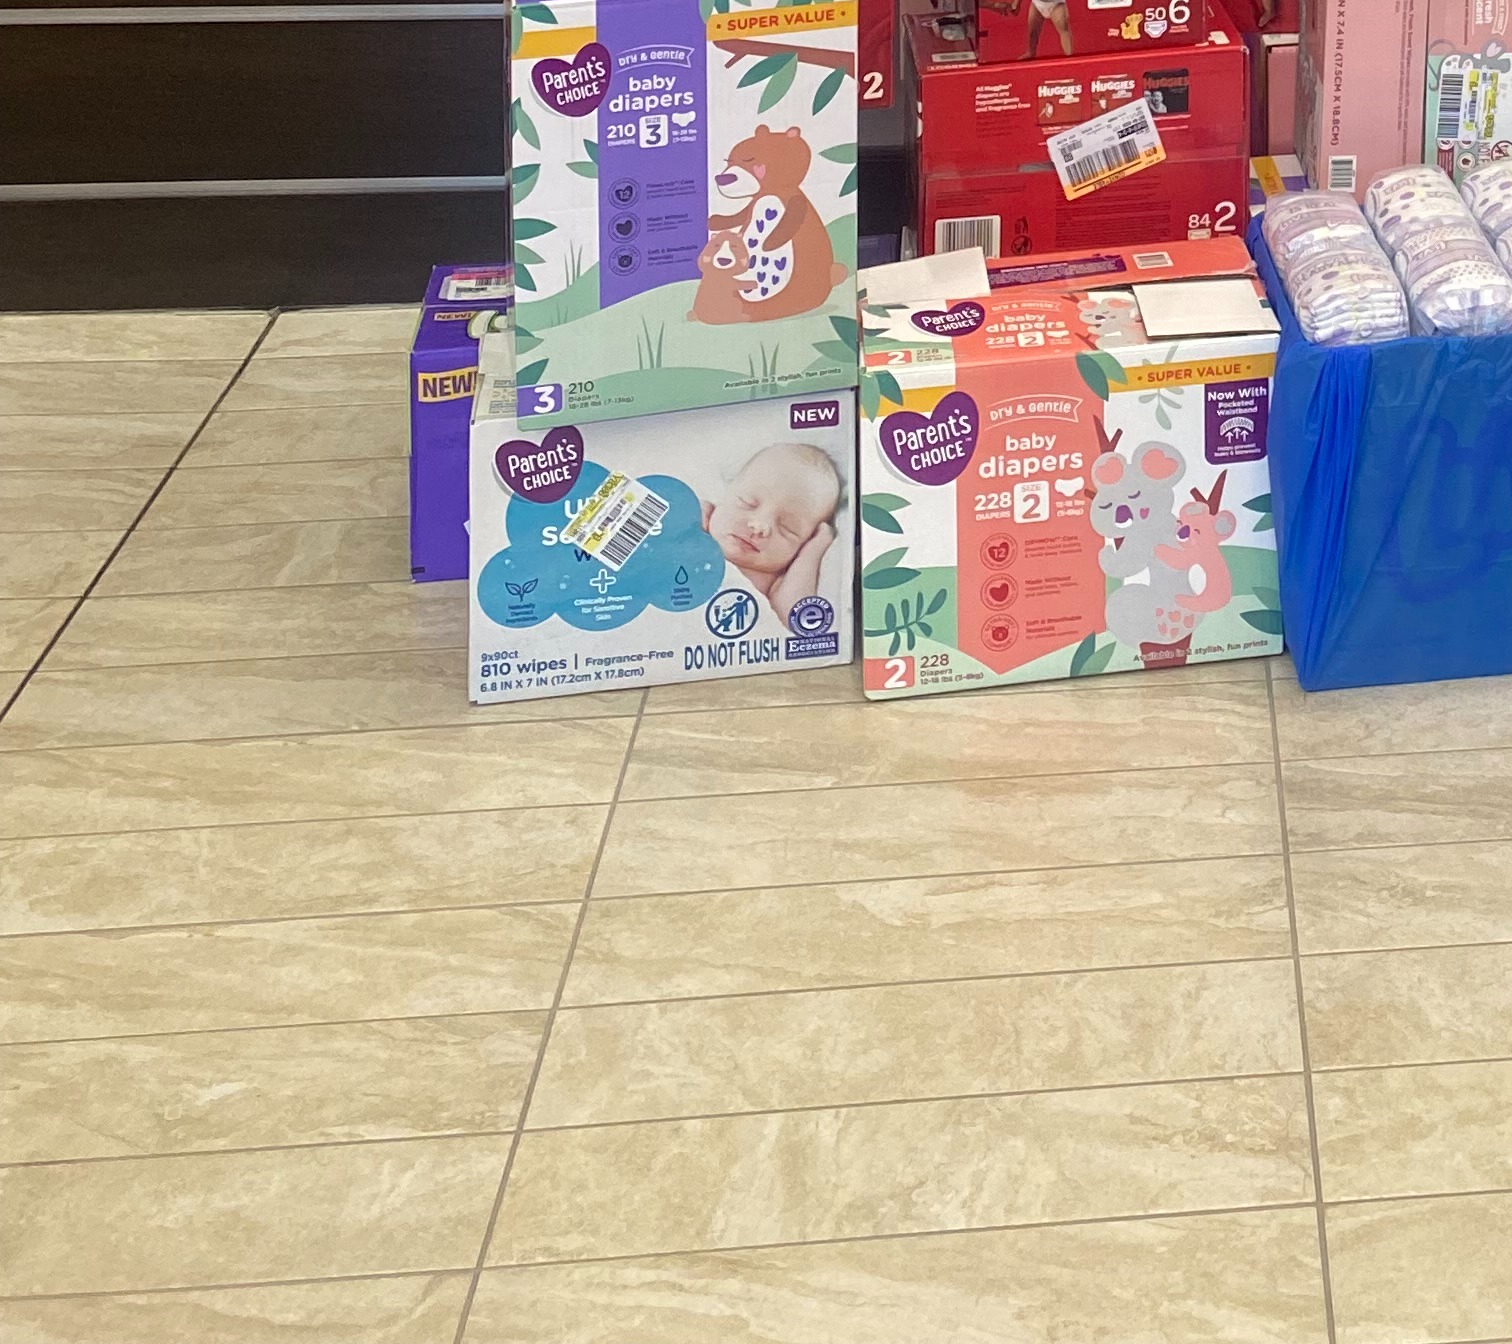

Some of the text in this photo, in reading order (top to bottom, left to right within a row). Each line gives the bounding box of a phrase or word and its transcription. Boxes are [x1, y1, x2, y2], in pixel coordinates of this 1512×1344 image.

[727, 8, 835, 32] SUPER VALUE
[1144, 7, 1167, 21] 50
[541, 55, 606, 94] Parent's
[629, 74, 677, 92] baby
[862, 71, 884, 100] 2
[1038, 84, 1083, 98] HUGGIES
[1091, 80, 1136, 93] HUGGIES
[608, 91, 694, 113] diapers
[1187, 214, 1211, 230] 84
[1213, 201, 1237, 232] 2
[935, 319, 977, 333] CHOICE
[1004, 313, 1045, 324] baby
[1147, 363, 1242, 383] SUPER VALUE
[532, 380, 594, 414] 3 210
[1207, 386, 1267, 402] Now With
[793, 407, 836, 424] NEW
[1005, 432, 1057, 452] baby
[910, 441, 966, 472] CHOICE
[978, 452, 1083, 479] diapers
[684, 638, 780, 671] DO NOT FLUSH
[788, 639, 836, 653] Eczema
[480, 650, 519, 663] 9x90ct
[480, 648, 675, 678] 810 wipes Fragrance-Free
[883, 654, 949, 688] 2 228
